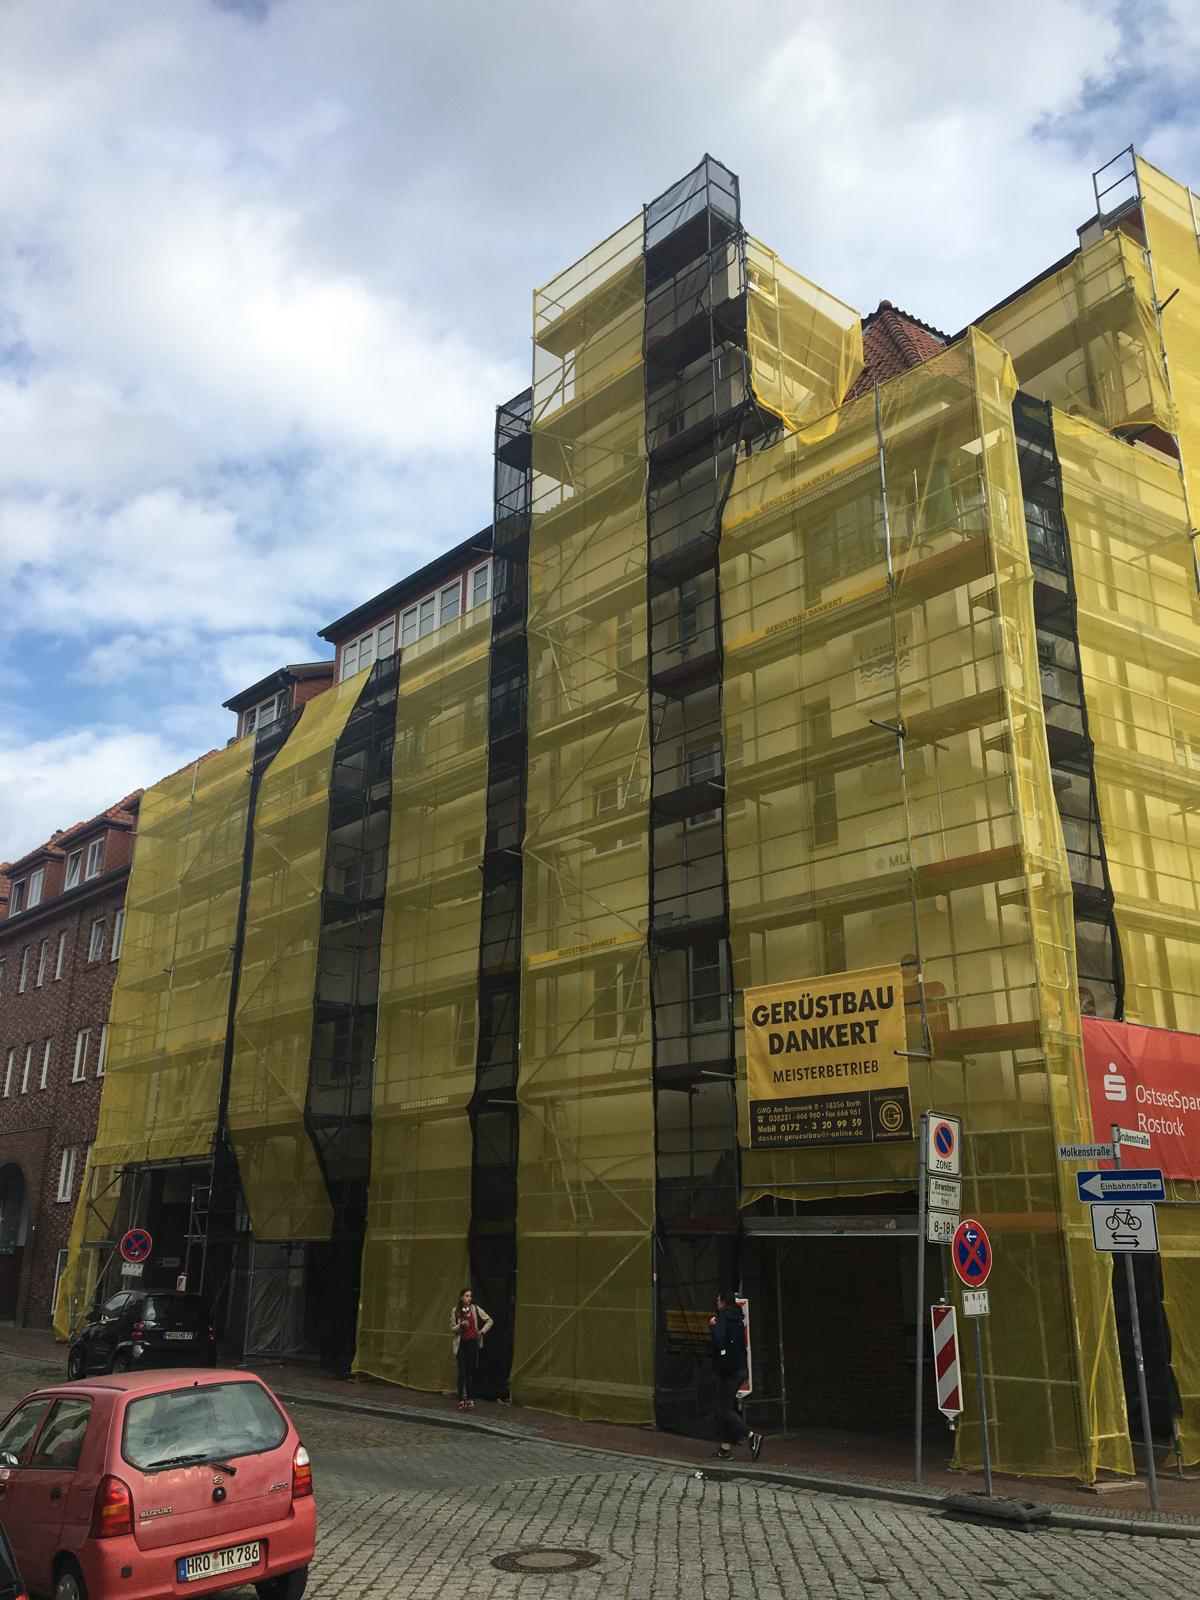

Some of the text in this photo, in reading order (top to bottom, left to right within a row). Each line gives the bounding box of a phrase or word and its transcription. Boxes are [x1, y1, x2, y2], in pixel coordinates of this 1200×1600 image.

[751, 985, 894, 1027] GERÜSTBAU
[768, 1019, 880, 1056] DANKERT
[773, 1060, 879, 1083] MEISTERBETRIEB
[757, 1124, 776, 1133] Mobil
[780, 1123, 800, 1132] 0172
[822, 1120, 832, 1129] 20
[836, 1118, 848, 1128] 99
[852, 1117, 863, 1127] 59
[1137, 1112, 1186, 1137] Rostock
[1060, 1146, 1111, 1157] Molkenstraße
[935, 1159, 952, 1171] ZONE
[1100, 1181, 1158, 1191] Einbahnstraße
[139, 1506, 173, 1518] SUZUKI
[186, 1555, 211, 1575] HRO
[220, 1549, 235, 1567] TR
[236, 1544, 259, 1563] 786
